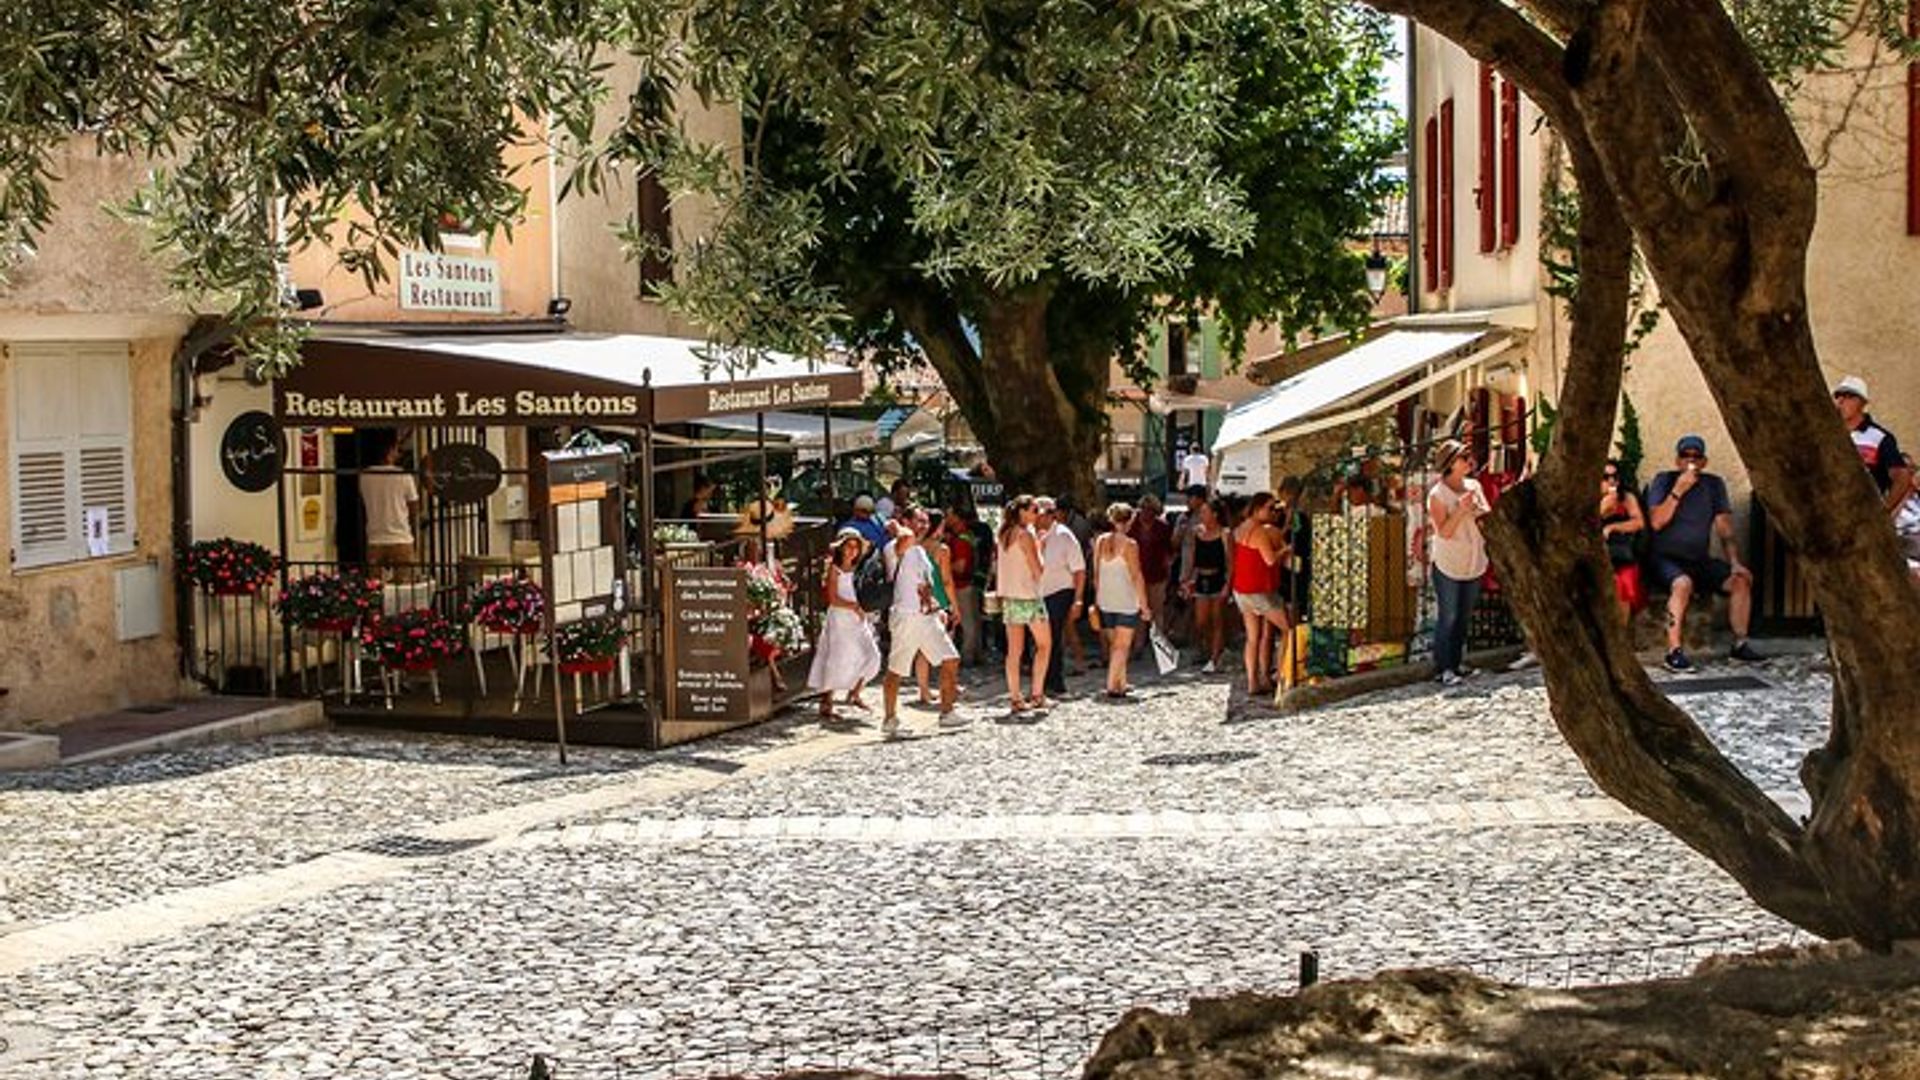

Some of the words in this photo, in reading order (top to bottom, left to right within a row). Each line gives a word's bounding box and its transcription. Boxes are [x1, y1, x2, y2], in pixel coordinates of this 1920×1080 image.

[405, 254, 431, 278] Les
[437, 257, 494, 283] Santons
[411, 283, 493, 307] Restaurant
[285, 391, 447, 417] Restaurant
[456, 392, 507, 417] Les
[516, 390, 639, 416] Santons
[708, 387, 771, 412] Restaurant
[773, 384, 791, 405] Les
[792, 381, 830, 402] Santons
